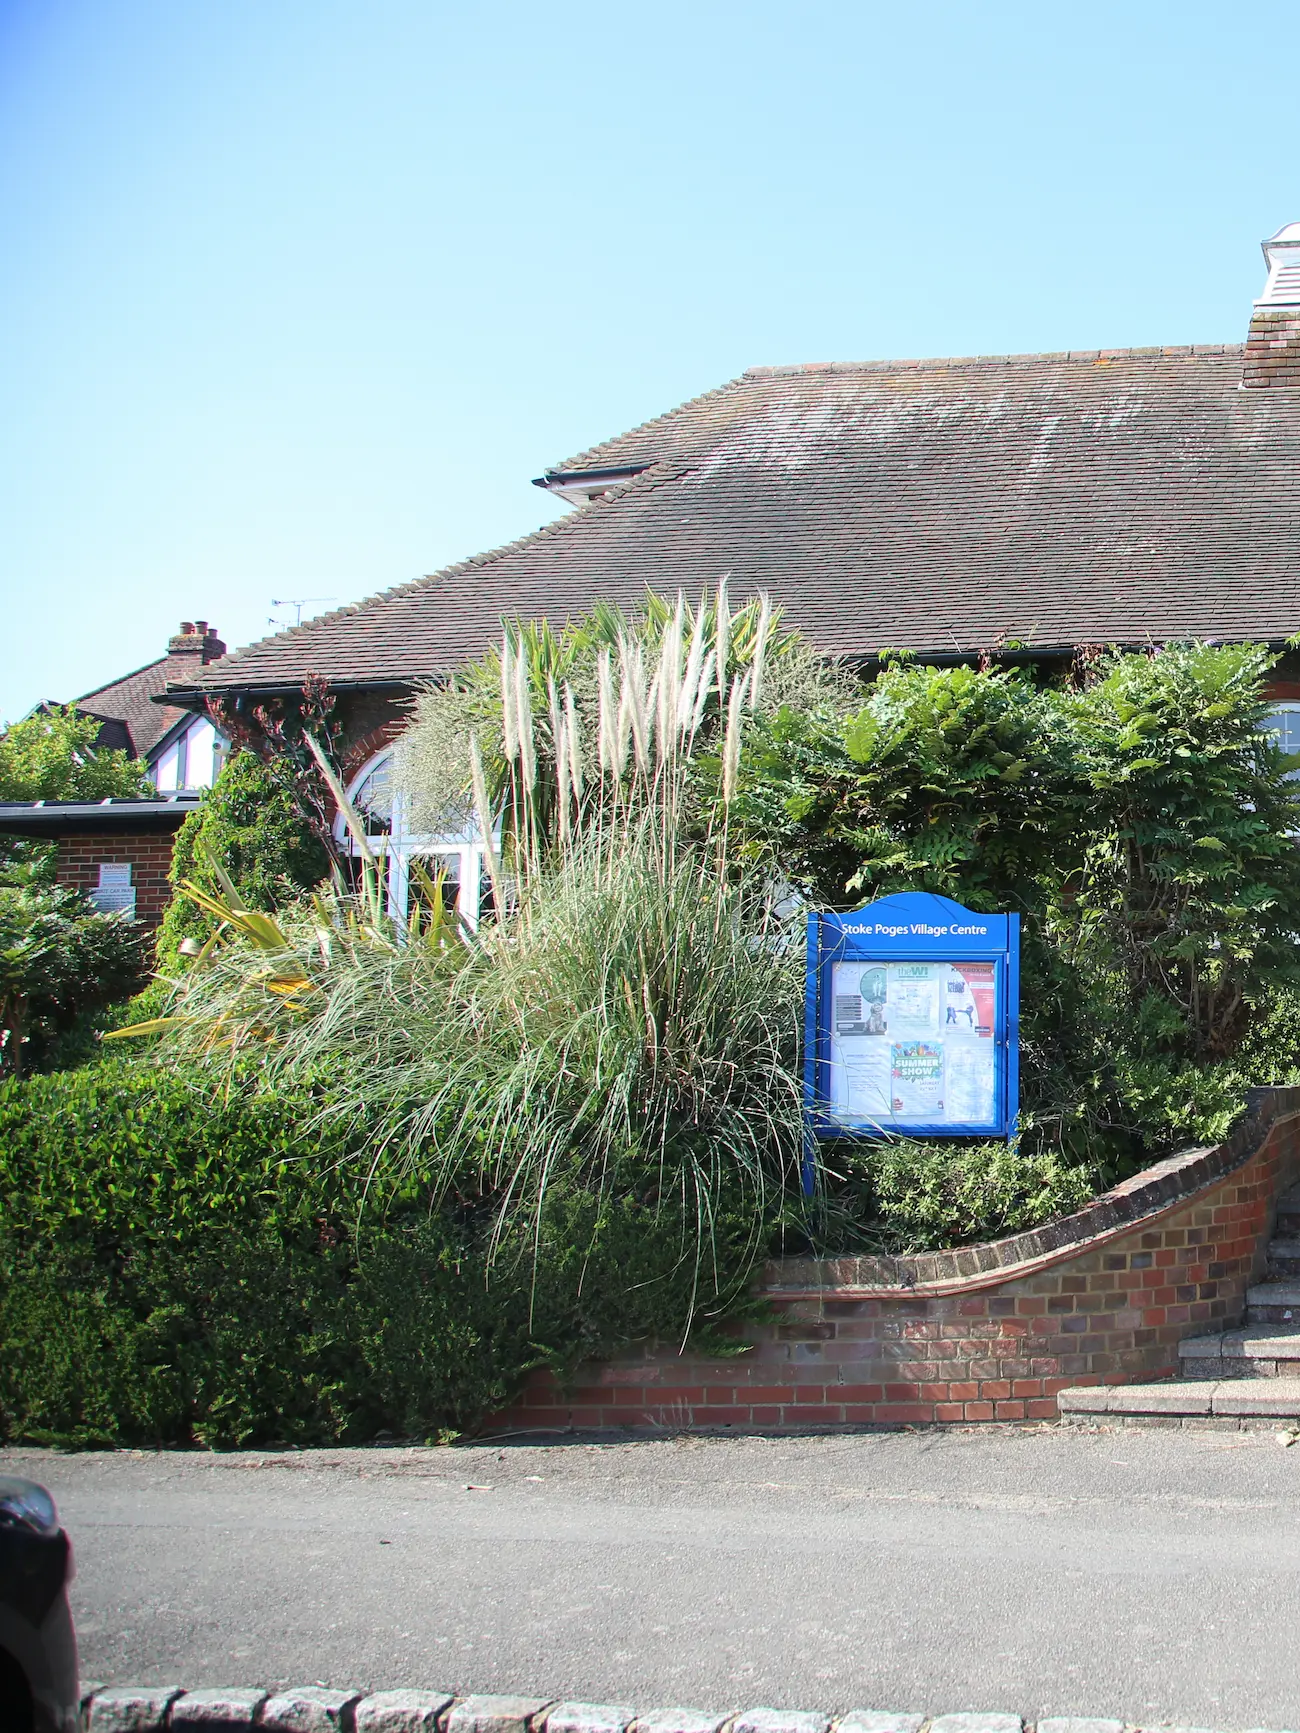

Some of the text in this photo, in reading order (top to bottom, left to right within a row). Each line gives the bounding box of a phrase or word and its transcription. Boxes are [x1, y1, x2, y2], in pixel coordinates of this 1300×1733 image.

[841, 923, 987, 937] Stoke Poges Village Centre
[895, 1058, 939, 1068] SUMMER
[901, 1067, 933, 1076] SHOW
